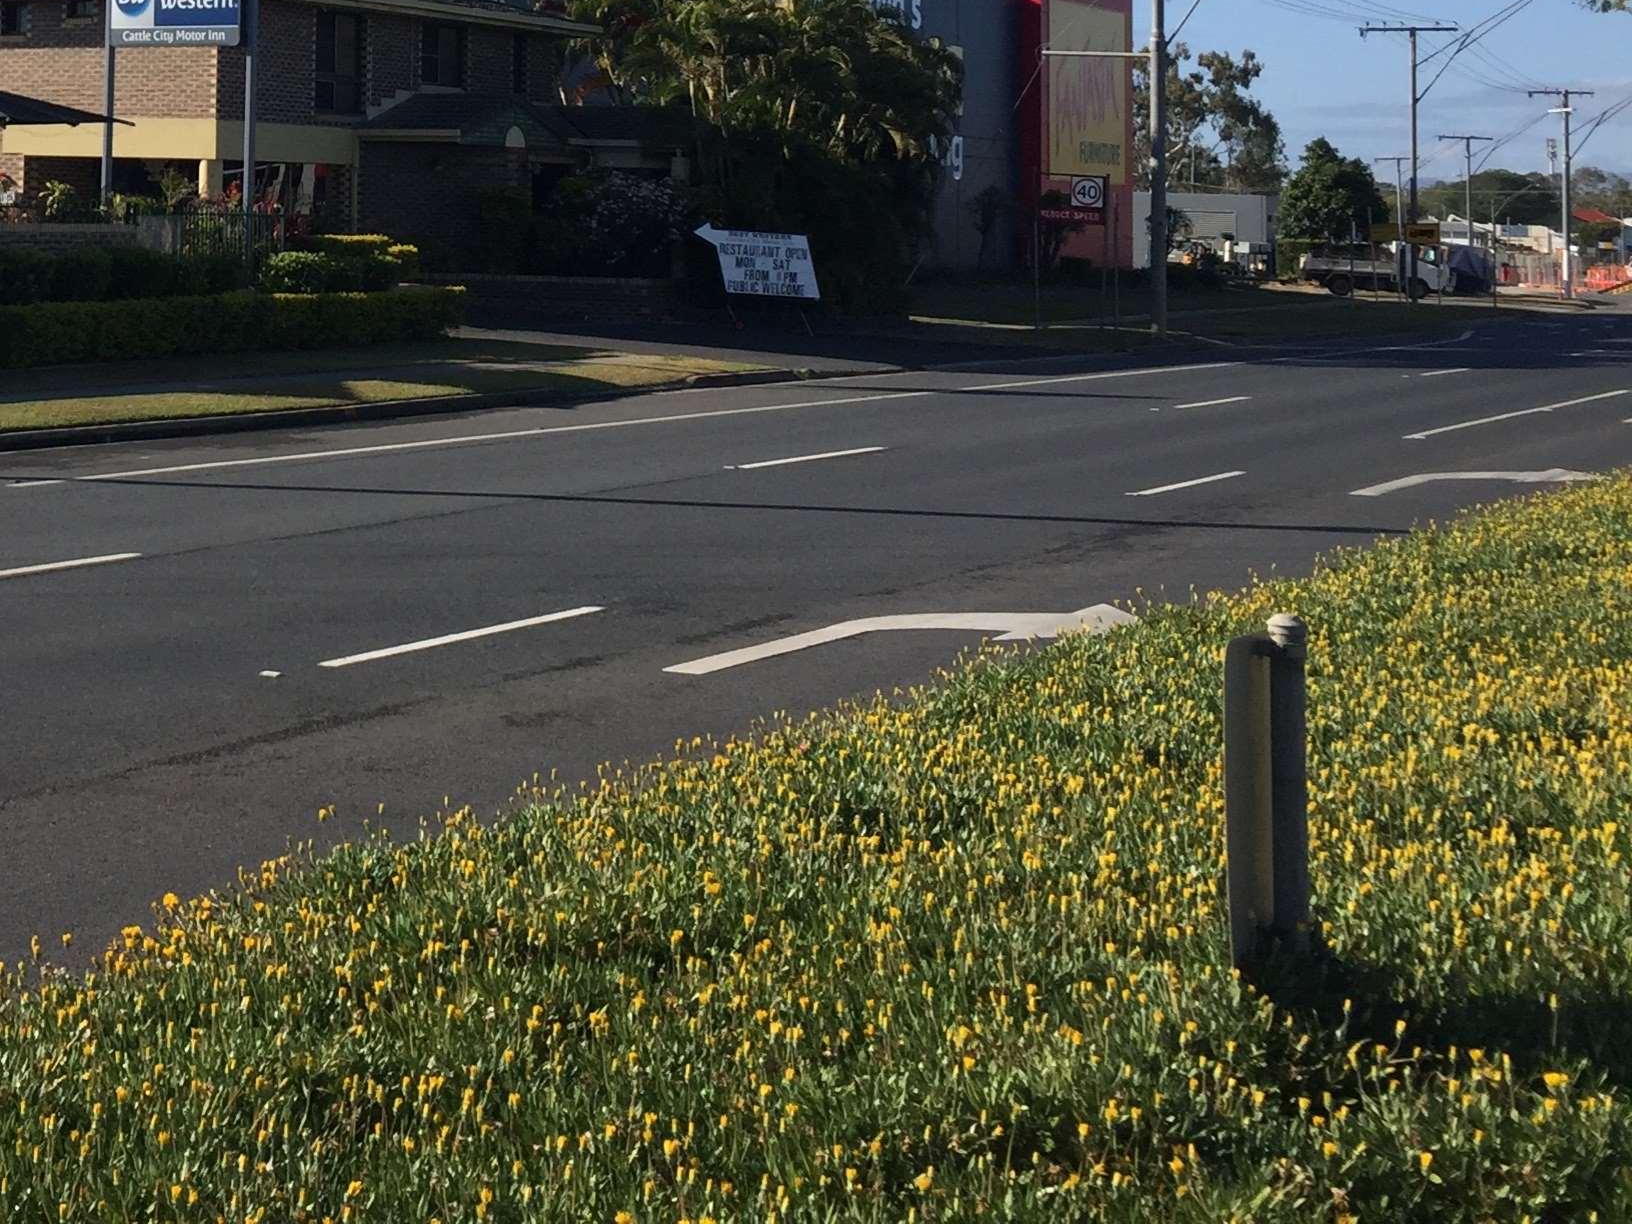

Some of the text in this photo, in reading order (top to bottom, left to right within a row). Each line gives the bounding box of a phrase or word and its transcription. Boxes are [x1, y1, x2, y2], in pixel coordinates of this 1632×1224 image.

[122, 30, 226, 43] Cattle City Motor Inn
[1077, 184, 1098, 199] 40
[735, 257, 756, 268] MON
[772, 258, 793, 271] SAT
[744, 269, 770, 282] FROM
